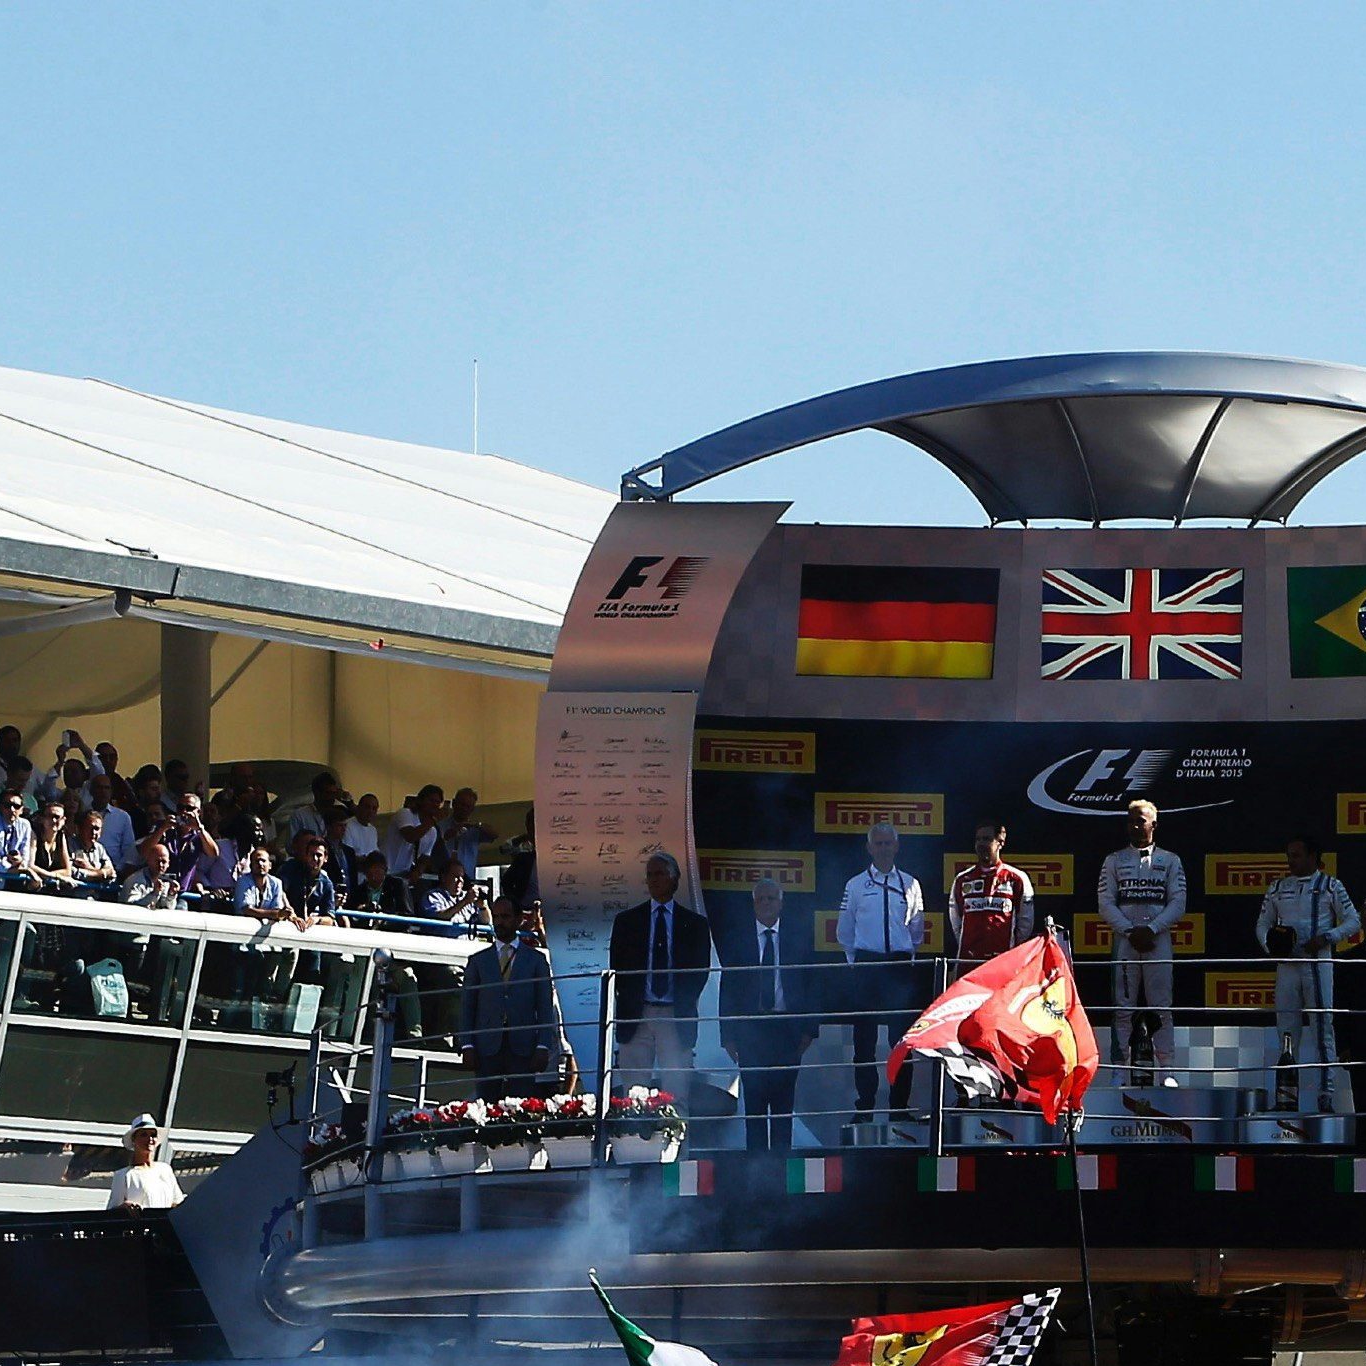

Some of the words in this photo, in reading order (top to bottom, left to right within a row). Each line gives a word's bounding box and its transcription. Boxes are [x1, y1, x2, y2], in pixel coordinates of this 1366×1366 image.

[597, 603, 618, 611] FIA
[621, 603, 670, 611] Formula
[613, 706, 666, 715] CHAMPIONS
[699, 737, 805, 765] PIRELLI
[1190, 748, 1238, 757] FORMULA
[1182, 759, 1212, 767] GRAN
[1215, 758, 1252, 767] PREMIO
[1220, 769, 1243, 778] 2015
[1067, 792, 1113, 802] Formula
[825, 801, 933, 826] PIRELLI
[699, 857, 804, 884] PIRELLI
